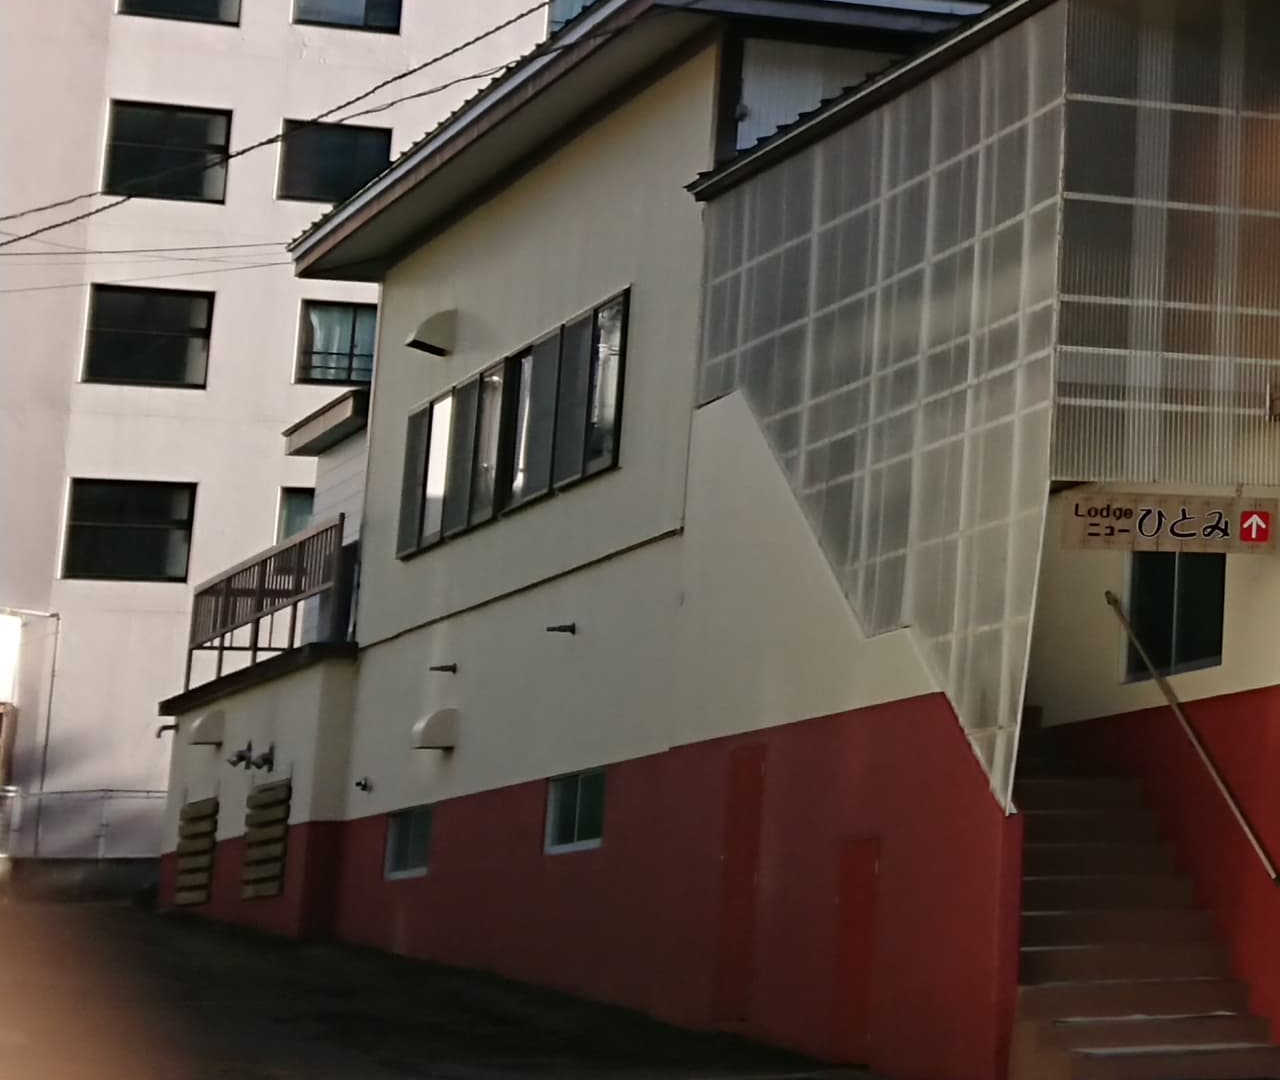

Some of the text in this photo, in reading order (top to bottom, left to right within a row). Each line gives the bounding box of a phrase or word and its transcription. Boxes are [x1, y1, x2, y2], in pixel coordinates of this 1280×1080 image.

[1074, 503, 1134, 520] Lodge
[1087, 507, 1231, 539] ニュー ひとみ
